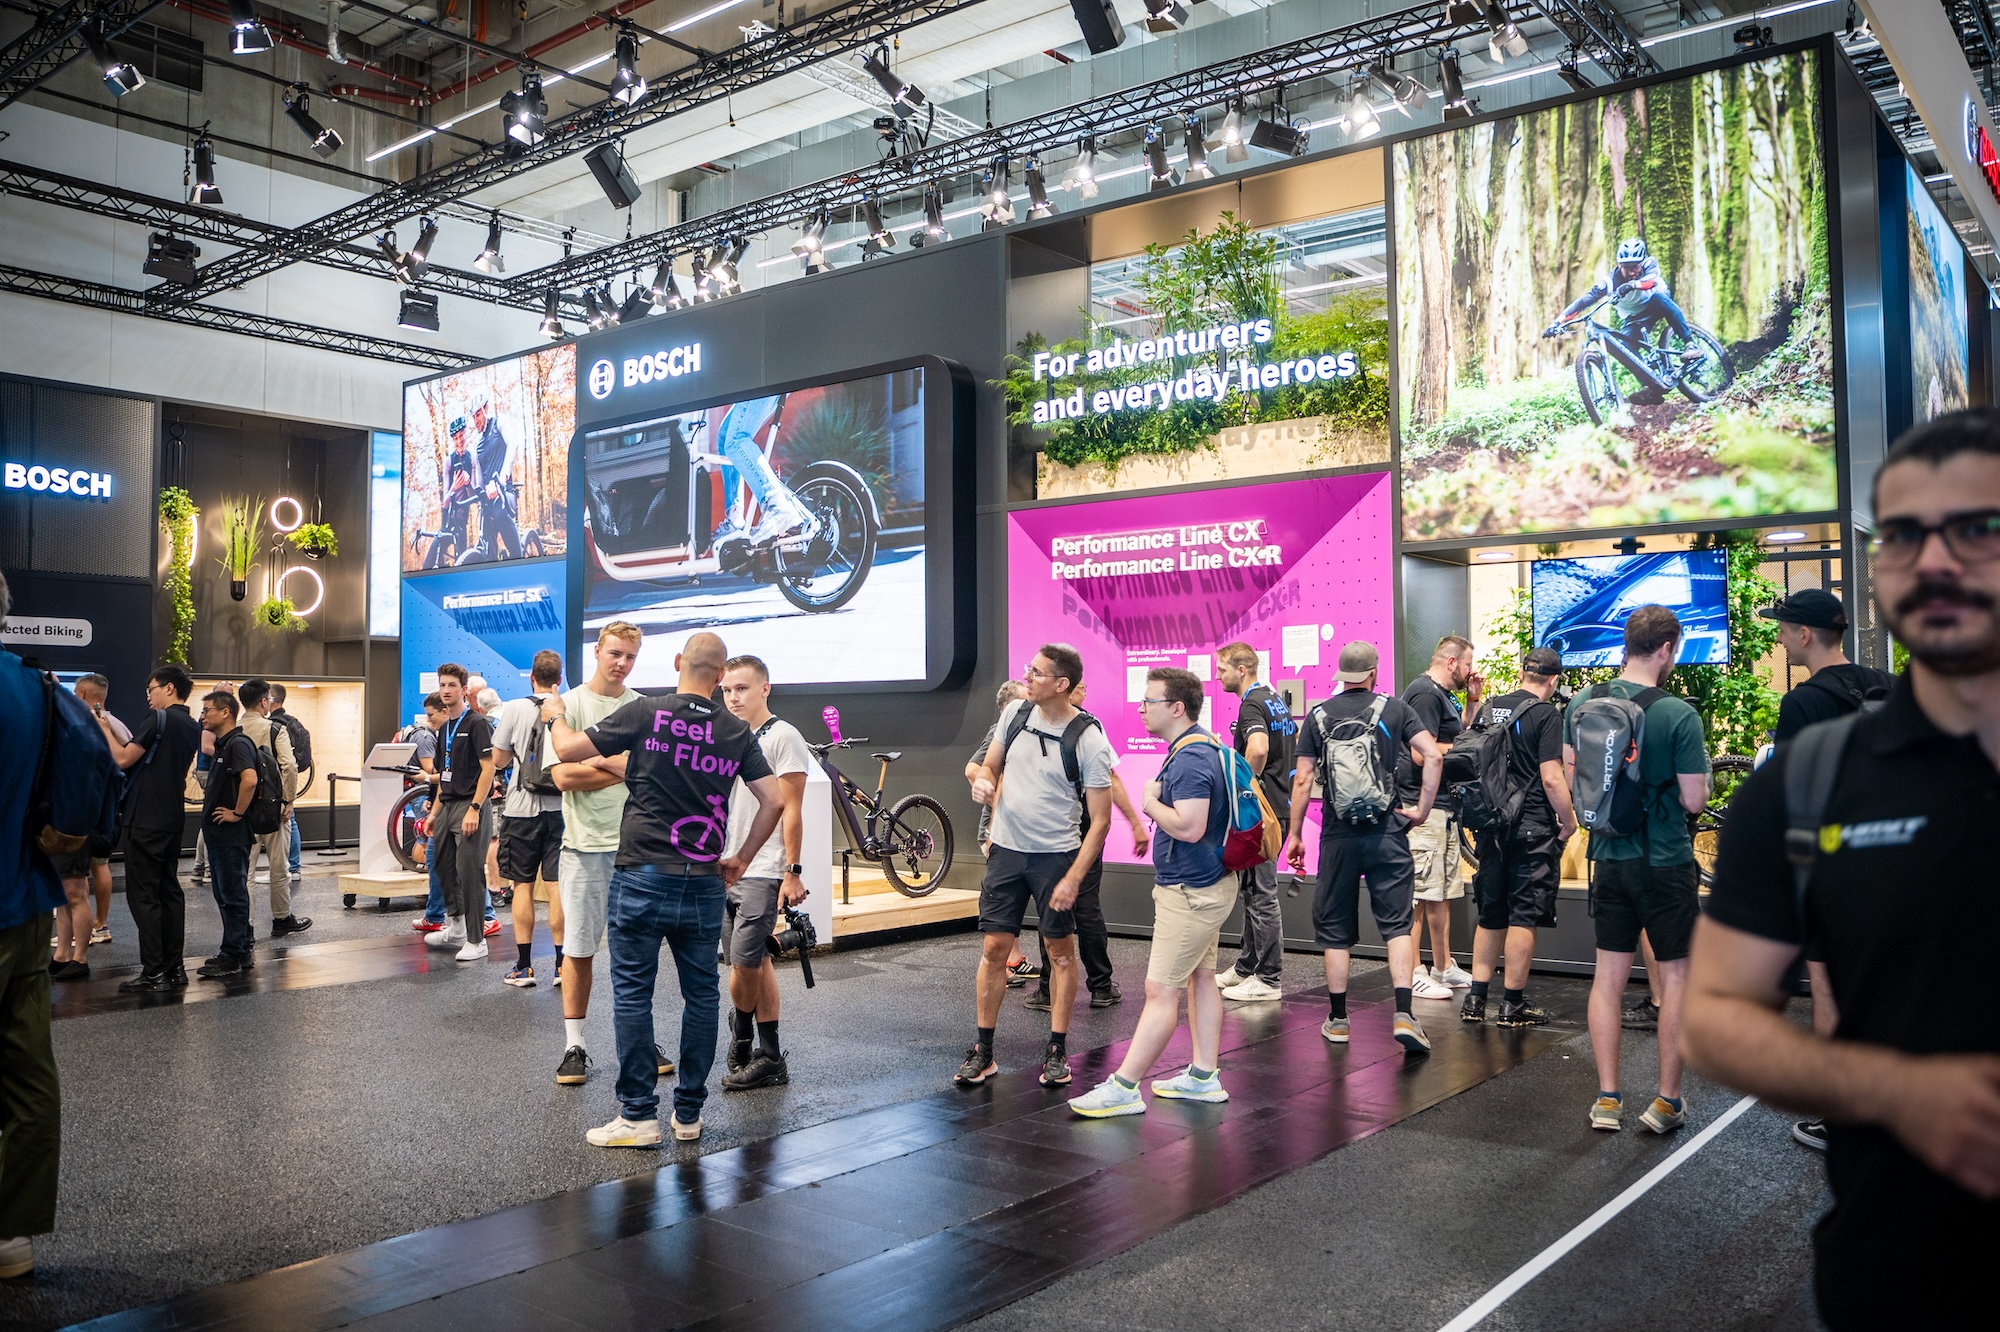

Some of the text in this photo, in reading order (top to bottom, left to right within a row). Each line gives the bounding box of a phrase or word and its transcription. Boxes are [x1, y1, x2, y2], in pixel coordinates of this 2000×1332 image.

[623, 342, 701, 388] BOSCH
[1033, 318, 1272, 381] For adventurers
[1032, 351, 1357, 423] and everyday heroes
[4, 462, 112, 498] BOSCH
[1051, 521, 1261, 557] Performance Line CX
[1051, 556, 1174, 580] Performance
[1180, 551, 1223, 572] Line
[443, 587, 543, 610] Performance Line SX
[44, 625, 83, 639] Biking
[653, 709, 715, 745] Feel
[644, 737, 741, 778] the Flow
[1602, 729, 1618, 792] ORTOVOX
